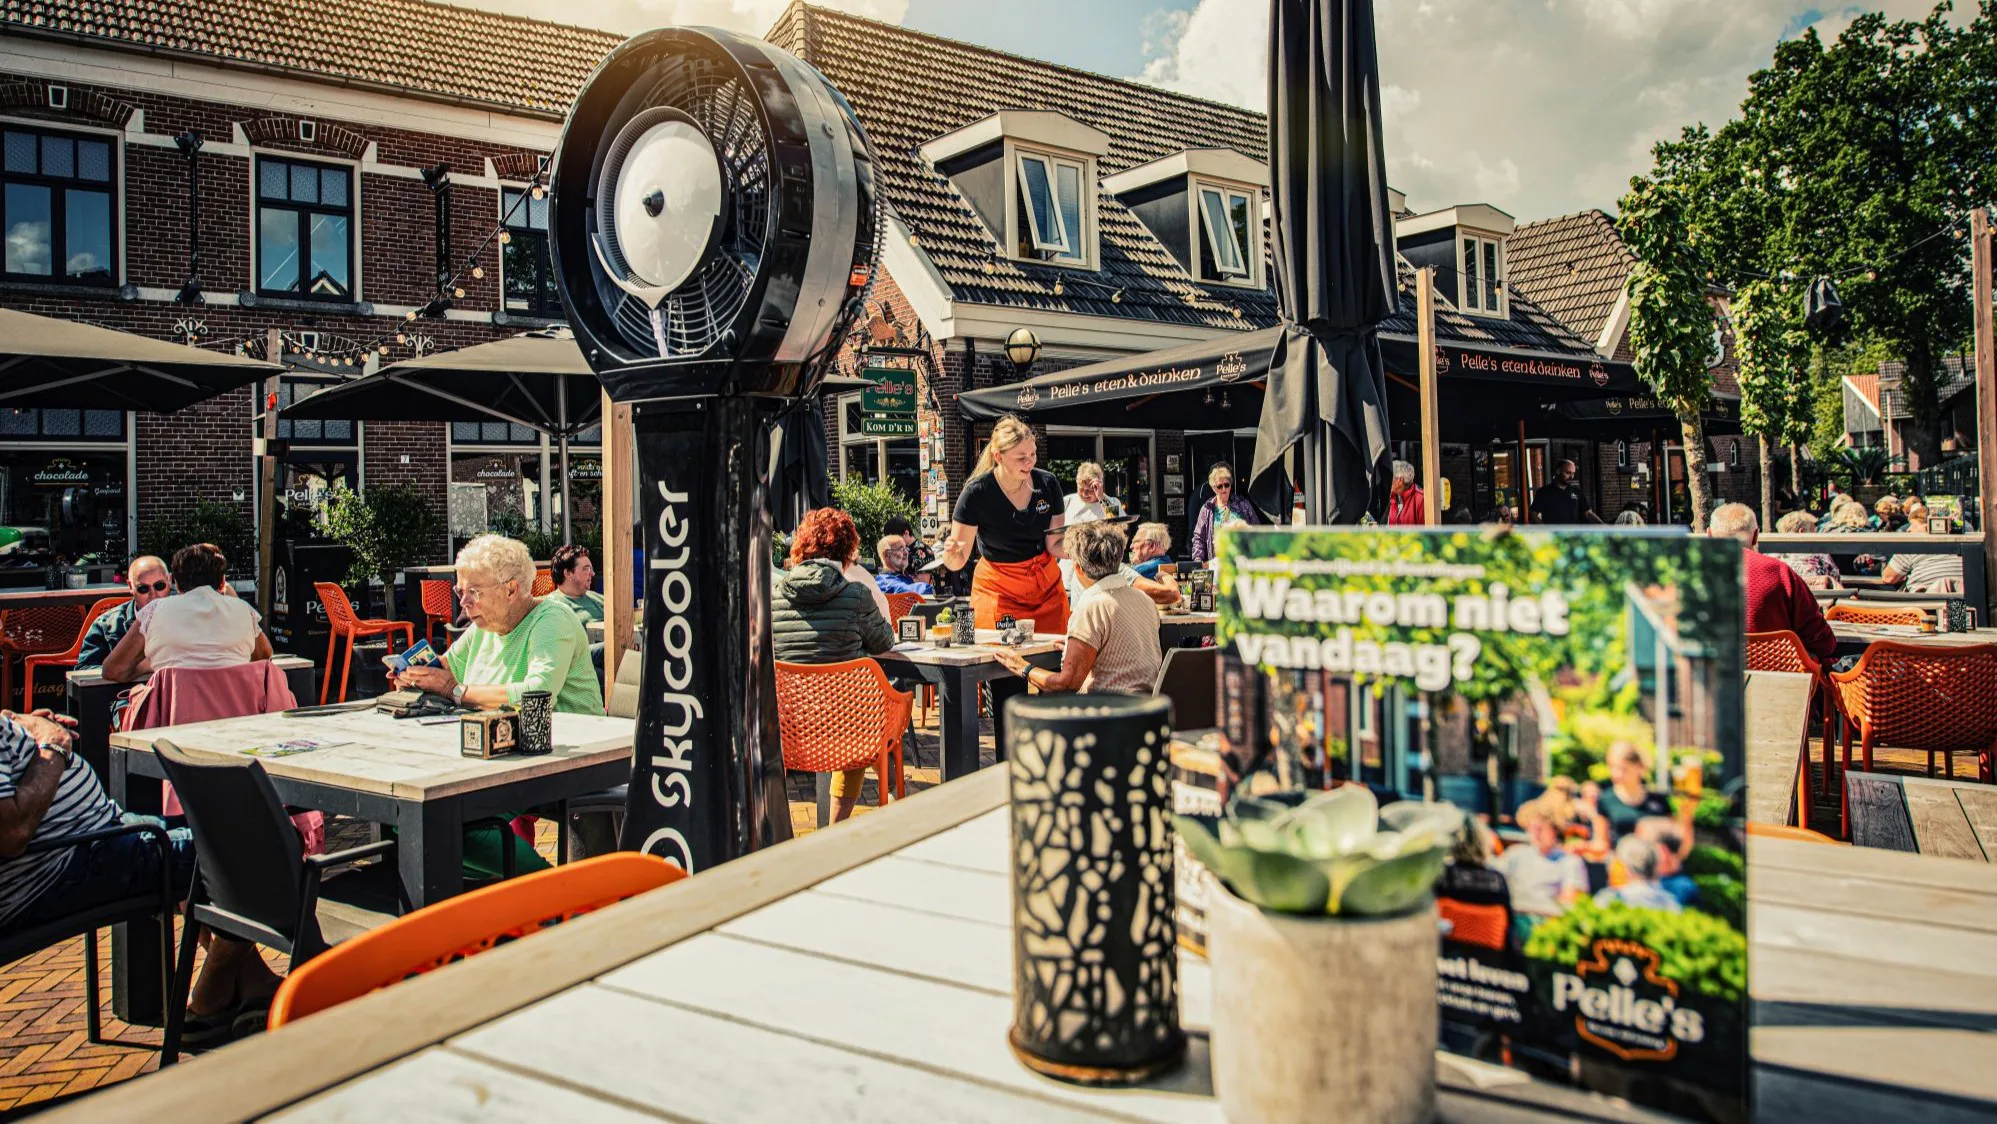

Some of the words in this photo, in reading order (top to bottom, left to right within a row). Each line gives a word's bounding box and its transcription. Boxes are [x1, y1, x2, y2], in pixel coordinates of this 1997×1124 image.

[1216, 361, 1247, 376] Pelle's
[1461, 353, 1498, 371] Pelle's
[1050, 382, 1090, 400] Pelle's
[1628, 397, 1655, 410] Pelle's
[905, 424, 914, 432] IN
[34, 470, 89, 481] chocolade
[477, 469, 515, 477] chocolade
[1235, 574, 1448, 628] Waarom
[1453, 581, 1571, 636] niet
[1234, 627, 1482, 692] vandaag?
[1552, 970, 1705, 1043] Pelle's
